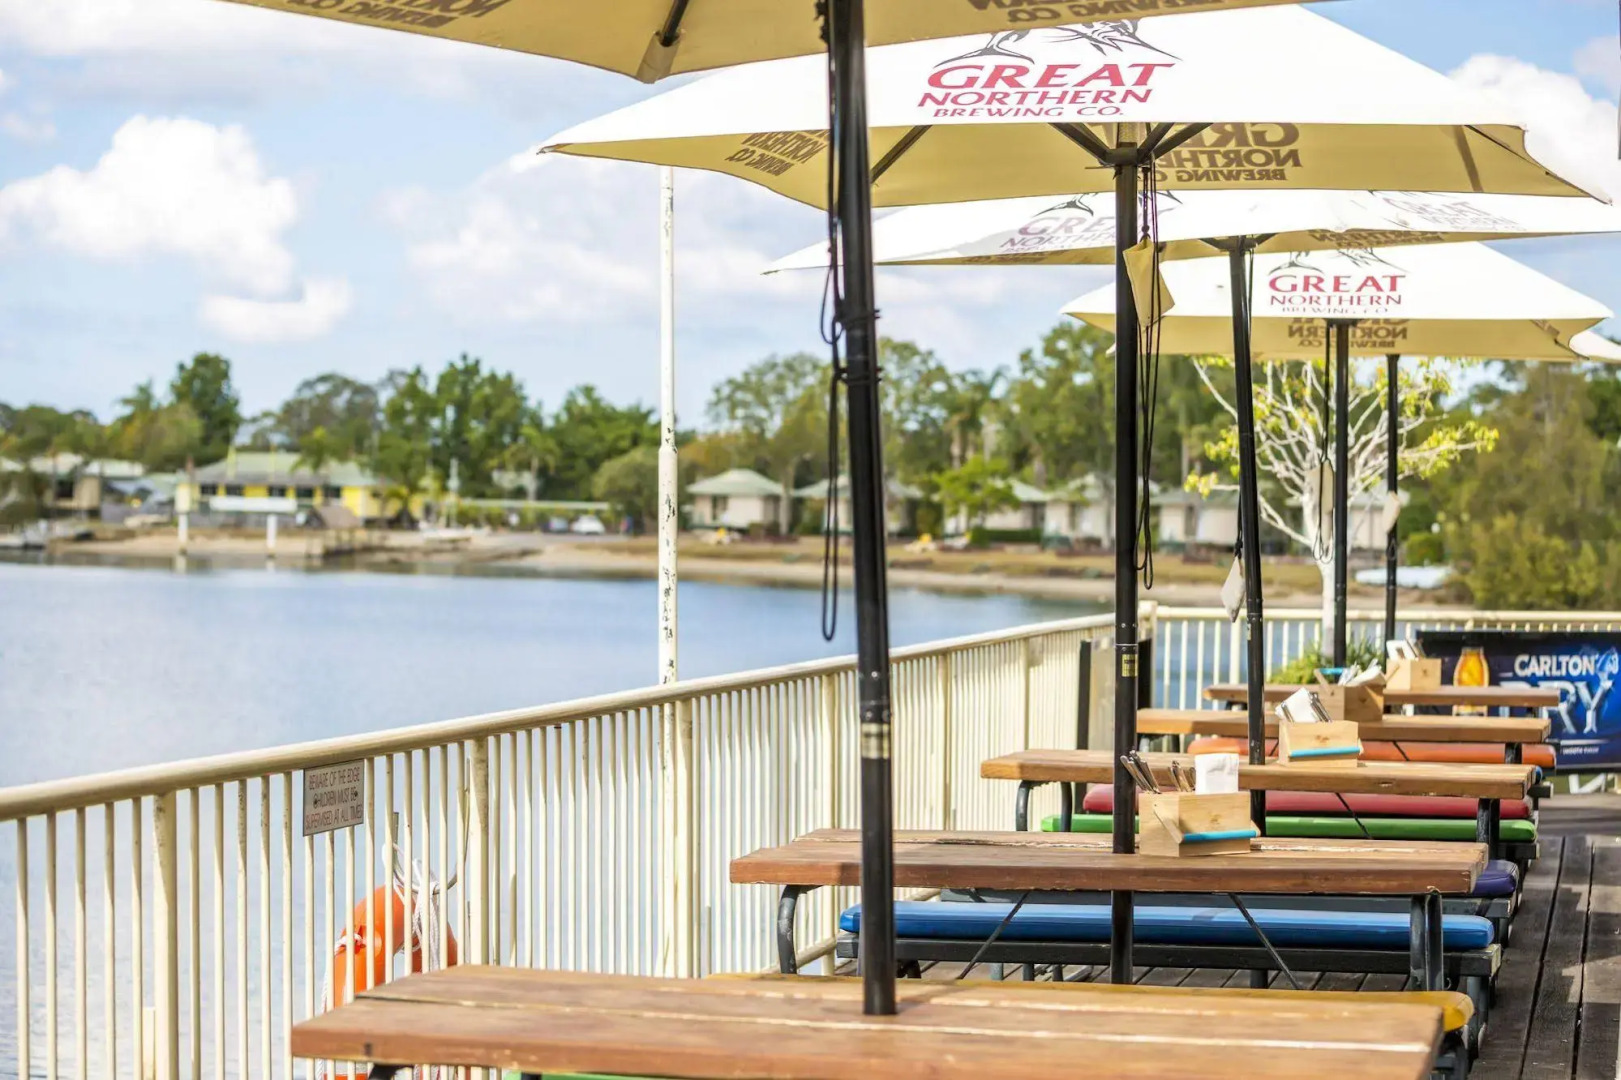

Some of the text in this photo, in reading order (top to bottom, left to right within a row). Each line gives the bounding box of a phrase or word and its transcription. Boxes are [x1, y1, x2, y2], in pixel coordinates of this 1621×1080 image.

[927, 63, 1176, 89] GREAT
[918, 89, 1153, 107] NORTHERN
[933, 106, 1123, 118] BREWING CO.
[1268, 274, 1407, 293] GREAT
[1270, 294, 1403, 306] NORTHERN
[1514, 654, 1597, 678] CARLTON
[309, 766, 360, 790] BEWARE OF THE EDGE
[337, 787, 350, 804] MUST
[306, 804, 363, 830] SUPERVISED AT ALL TIMES
